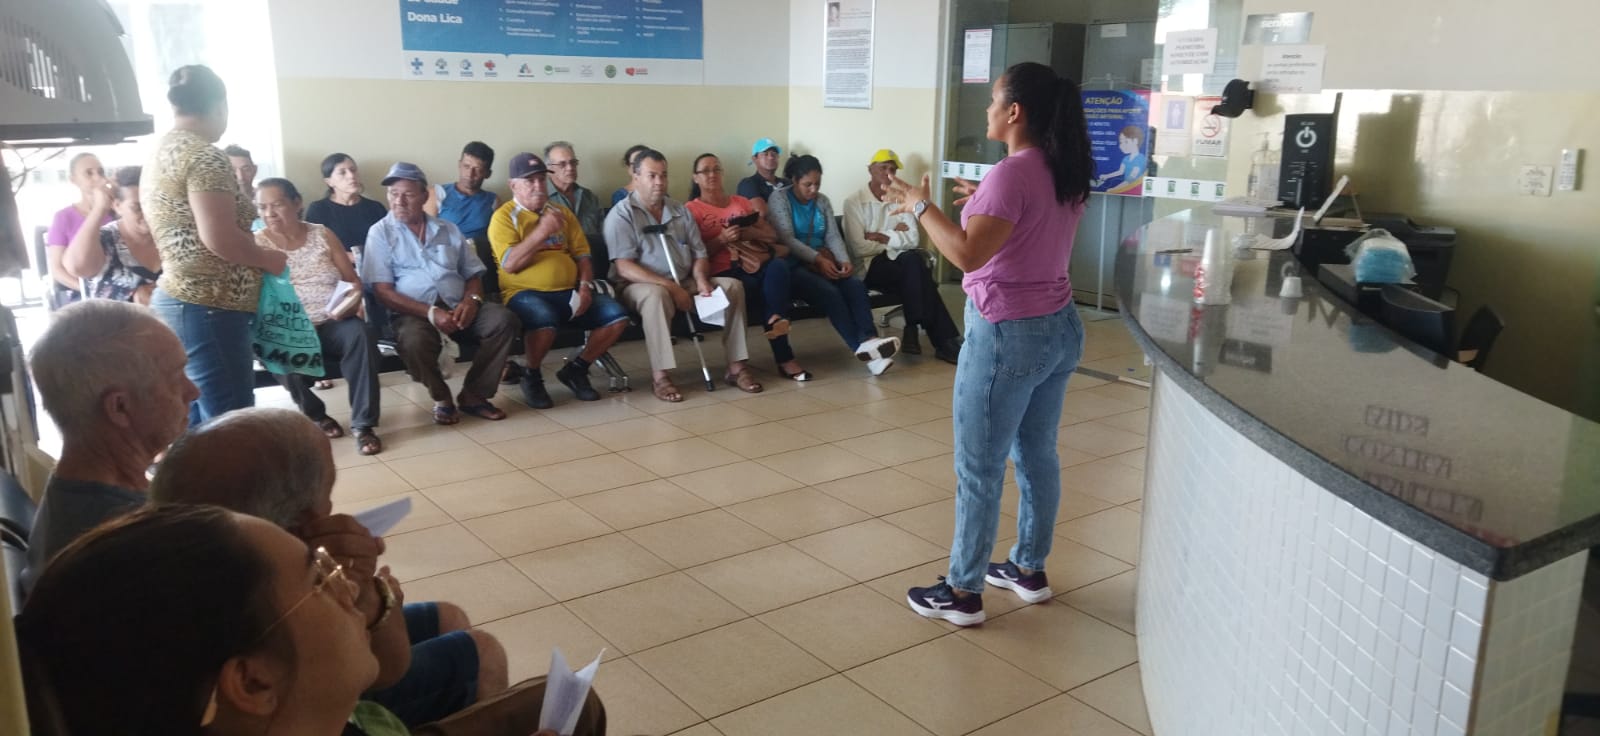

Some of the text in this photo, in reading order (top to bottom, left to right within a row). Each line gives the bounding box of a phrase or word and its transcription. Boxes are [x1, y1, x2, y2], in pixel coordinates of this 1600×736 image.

[407, 11, 464, 24] Dona Lica
[1085, 96, 1124, 107] ATENÇÃO
